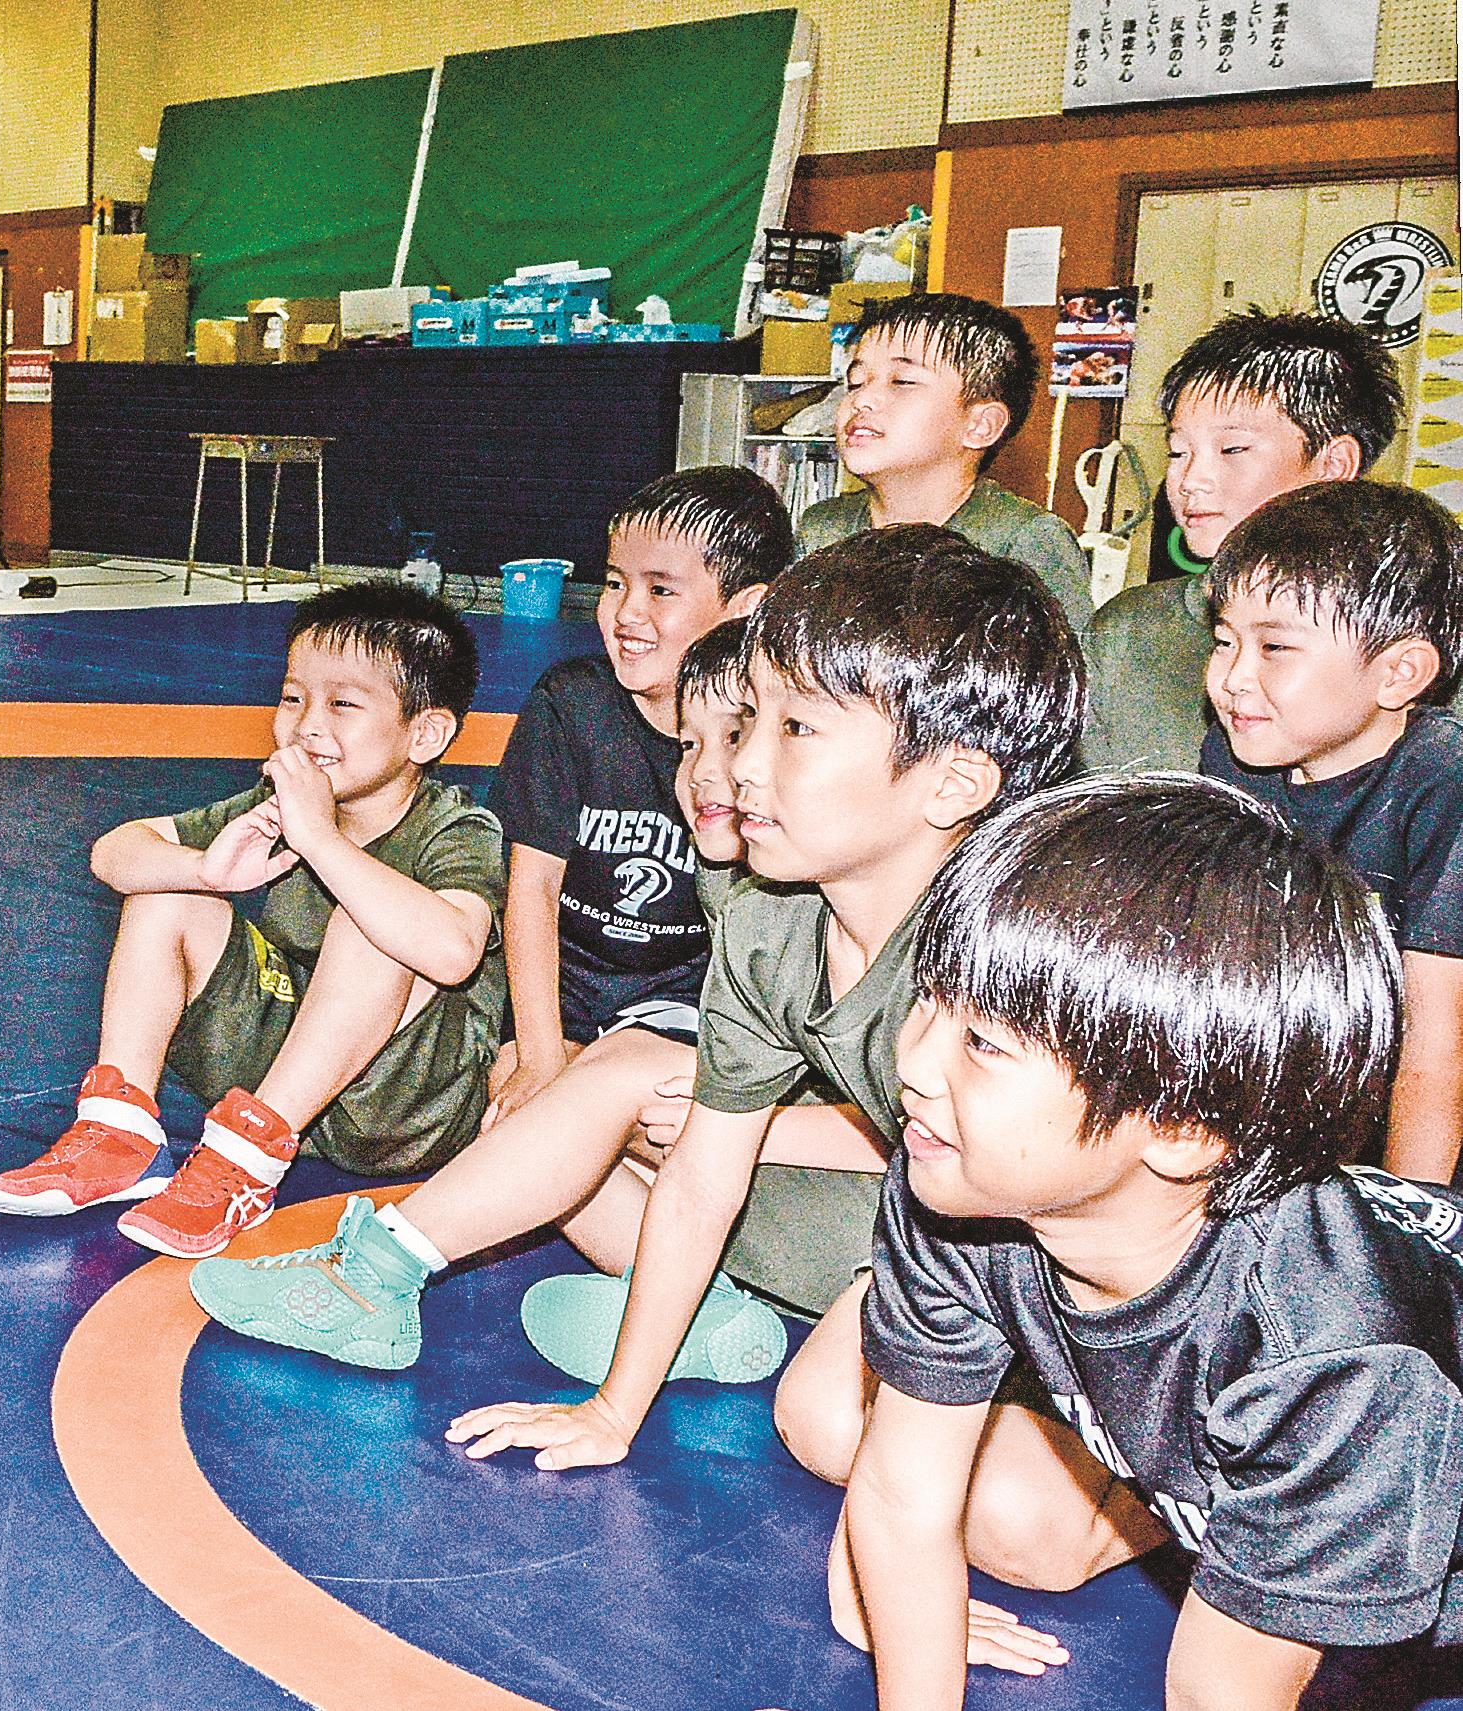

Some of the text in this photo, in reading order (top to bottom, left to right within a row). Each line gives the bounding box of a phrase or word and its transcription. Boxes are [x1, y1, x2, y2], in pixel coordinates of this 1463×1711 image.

[1166, 16, 1186, 79] 反省の心
[1215, 10, 1237, 74] 感謝の心
[1268, 2, 1289, 69] 素直な心
[582, 904, 611, 923] B&G
[613, 915, 685, 936] WRESTLING
